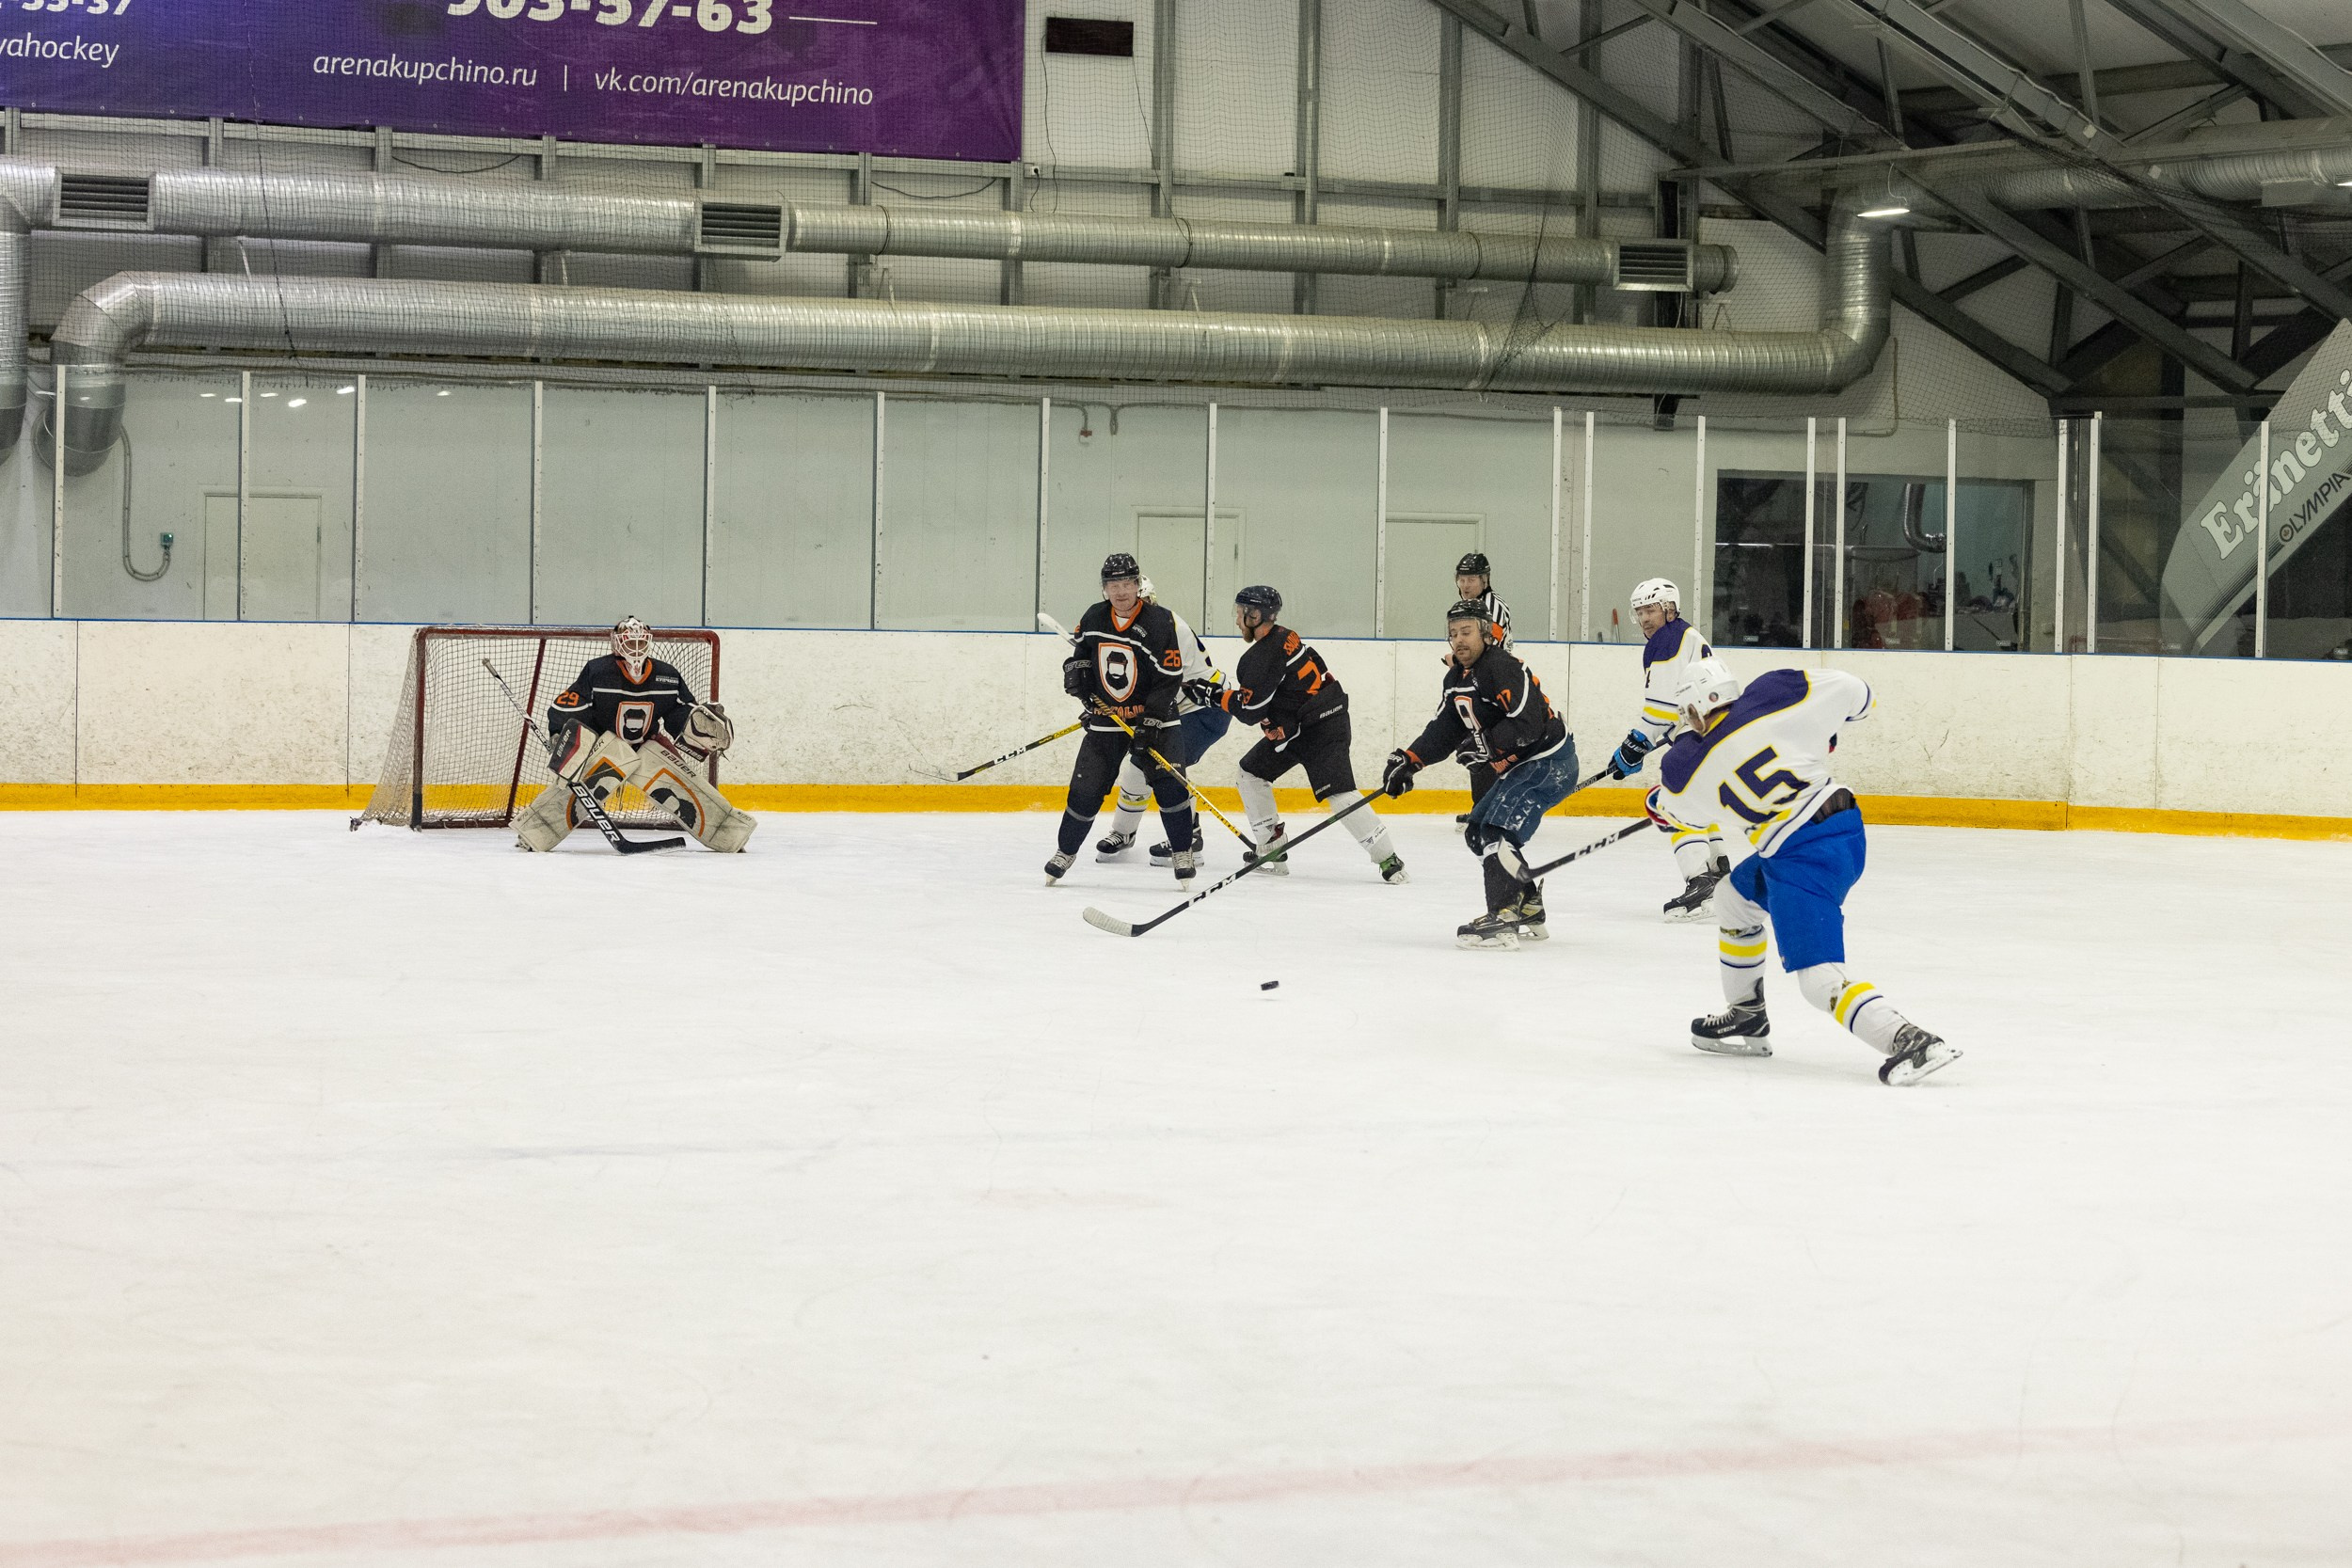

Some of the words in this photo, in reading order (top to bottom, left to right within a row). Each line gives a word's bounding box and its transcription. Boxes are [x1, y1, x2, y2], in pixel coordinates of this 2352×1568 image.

[313, 54, 537, 87] arenakupchino.ru
[595, 67, 873, 107] vk.com/arenakupchino
[2280, 472, 2351, 543] OLYMPIA
[1163, 649, 1182, 667] 26
[556, 690, 580, 706] 29
[1496, 689, 1512, 712] 17
[660, 750, 696, 778] BAUER
[1718, 744, 1810, 824] 15
[572, 785, 621, 842] BAUER
[1574, 832, 1619, 860] CCM
